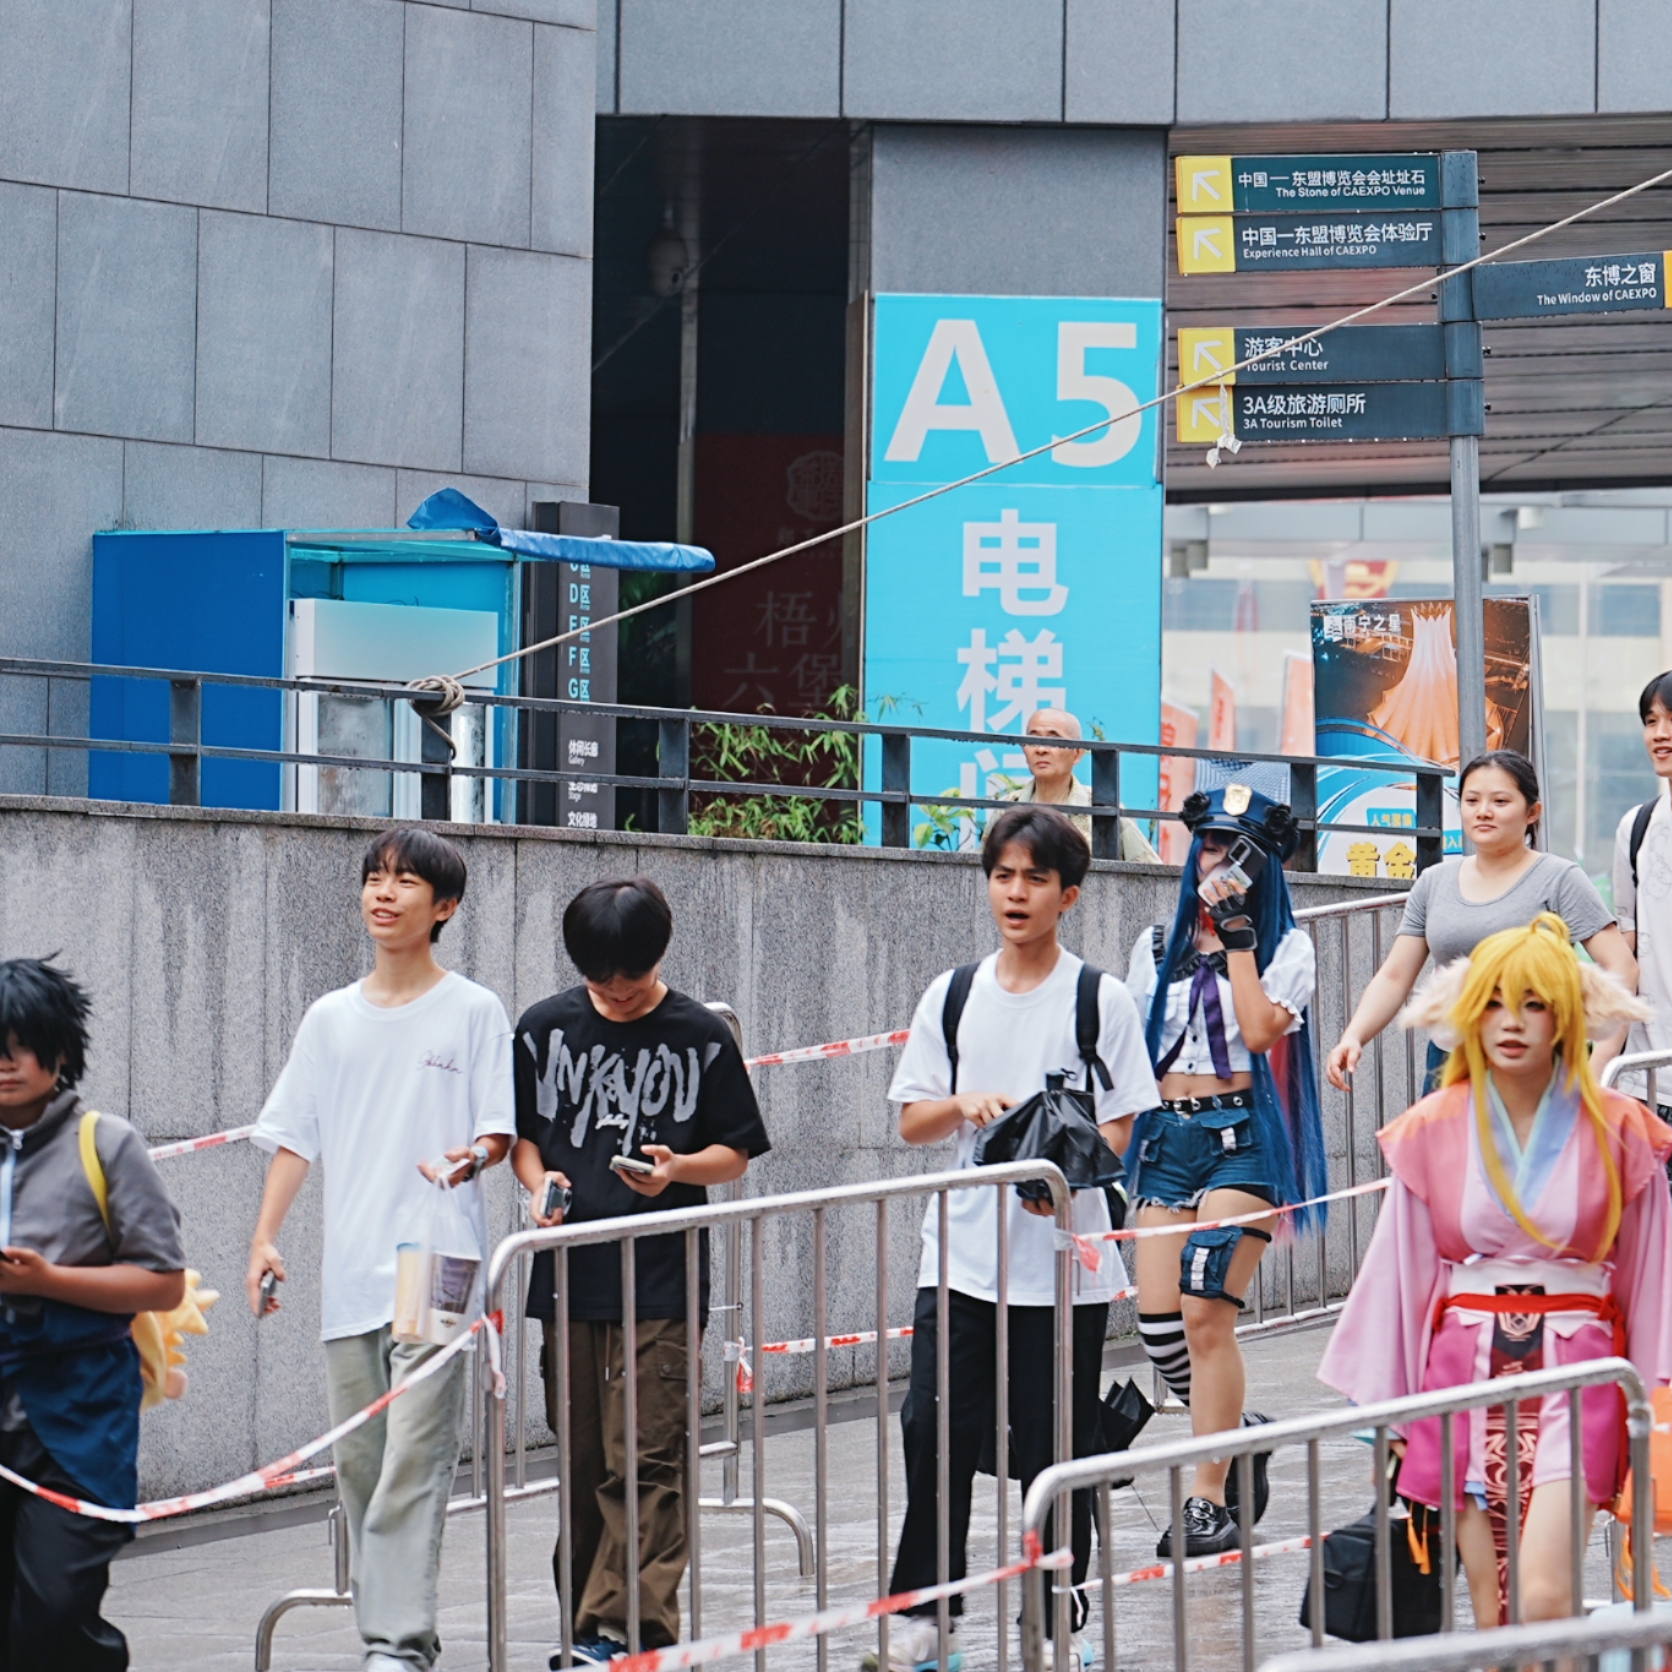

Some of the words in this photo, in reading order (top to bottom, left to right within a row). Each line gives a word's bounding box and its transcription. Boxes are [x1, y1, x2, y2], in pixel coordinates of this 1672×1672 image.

[1276, 186, 1295, 198] The
[1297, 185, 1328, 198] Stone
[1330, 185, 1341, 197] of
[1343, 184, 1391, 197] CAEXPO
[1392, 184, 1426, 196] Venue
[1243, 247, 1299, 259] Experience
[1301, 246, 1322, 258] Hall
[1323, 245, 1333, 256] of
[1335, 244, 1377, 256] CAEXPO
[1584, 263, 1656, 288] 东博之窗
[1537, 293, 1557, 306] The
[1558, 292, 1600, 305] Window
[1602, 291, 1613, 302] of
[1614, 287, 1657, 301] CAEXPO
[1244, 336, 1324, 359] 游客中心
[1290, 358, 1329, 371] Center
[884, 318, 1143, 468] A5
[1243, 392, 1367, 416] 3A级旅游厕所
[1243, 418, 1259, 430] 3A
[1260, 417, 1307, 429] Tourism
[1309, 416, 1343, 428] Toilet
[1344, 614, 1401, 632] 南宁之星
[956, 508, 1070, 852] 电梯
